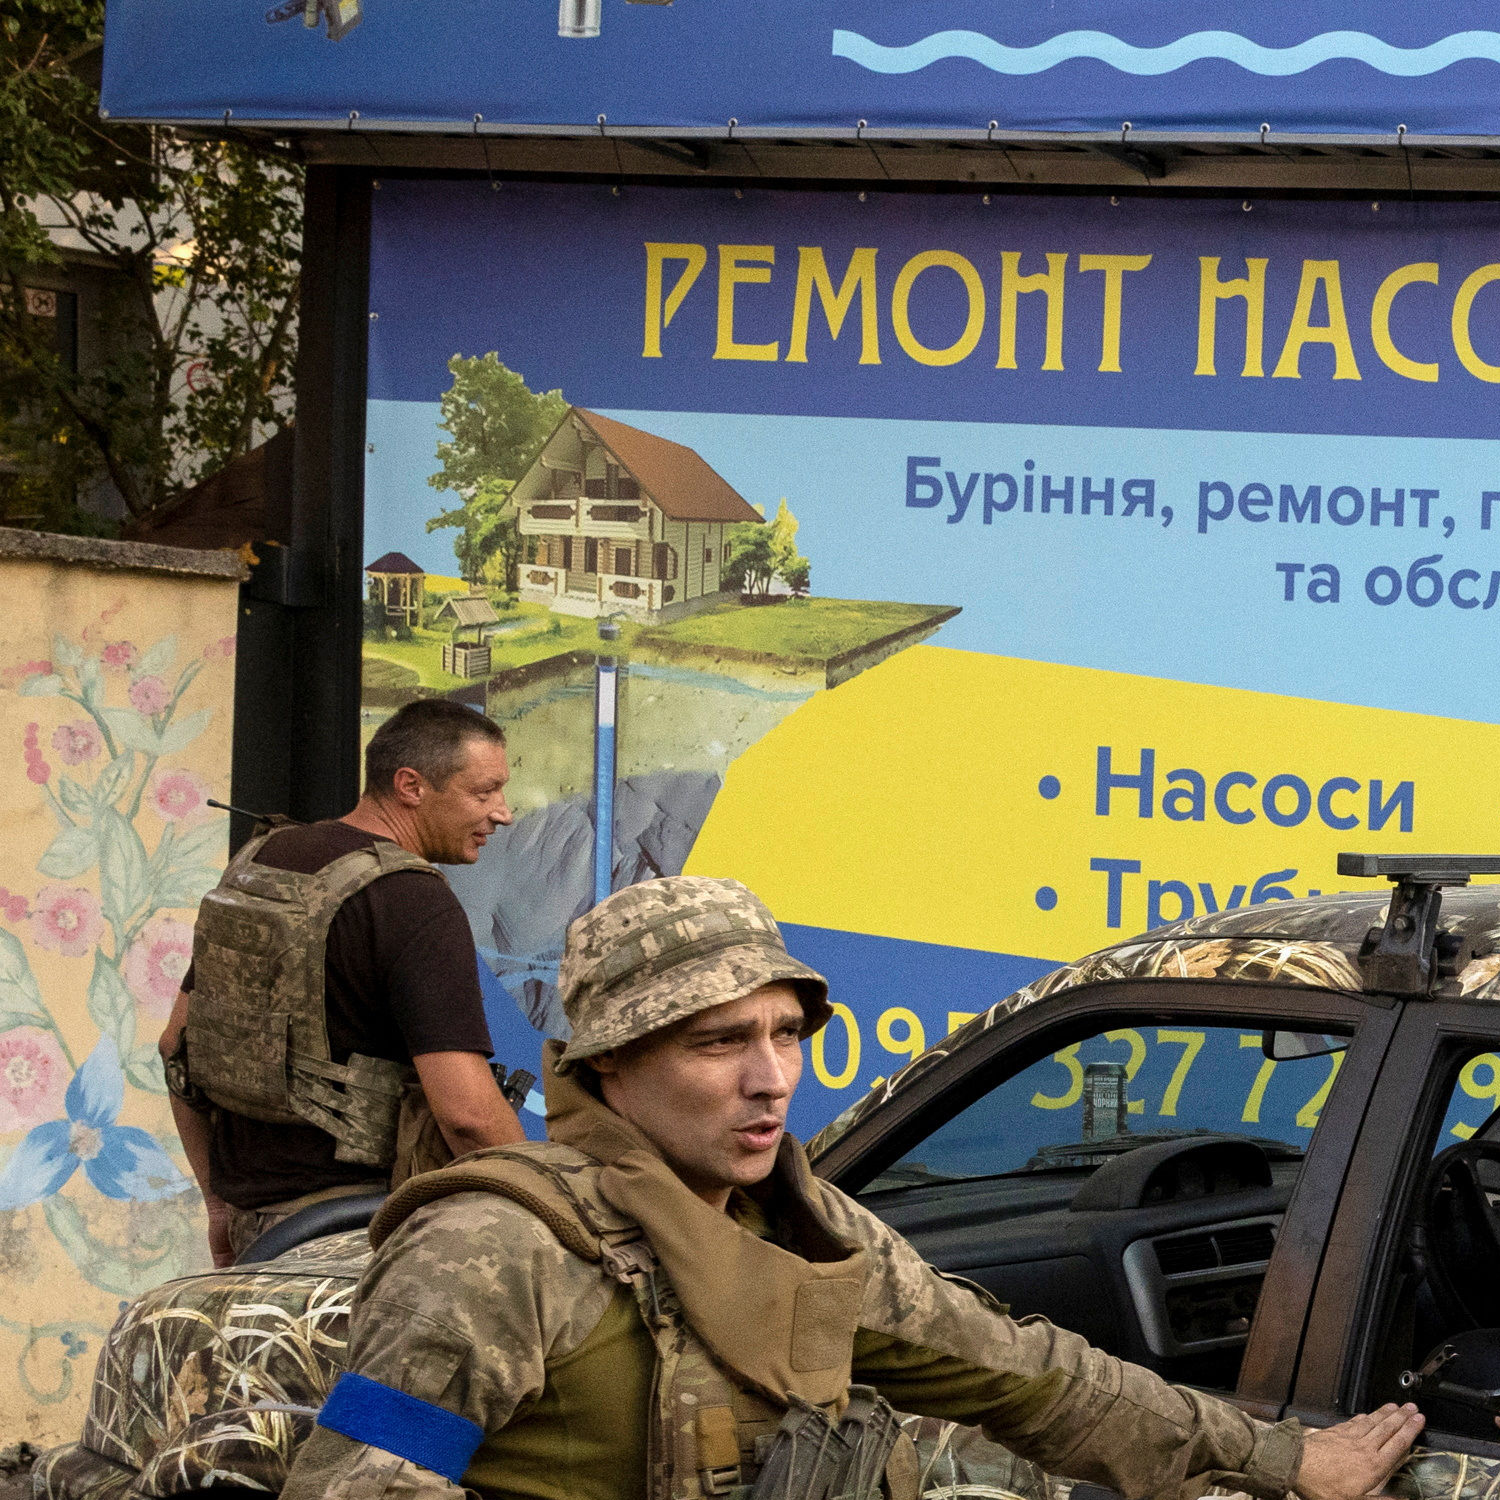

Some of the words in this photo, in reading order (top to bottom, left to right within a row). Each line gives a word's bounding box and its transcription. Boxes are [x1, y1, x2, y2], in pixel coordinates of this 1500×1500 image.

[642, 241, 1153, 372] РЕМОНТ
[905, 455, 1174, 528] Буріння,
[1197, 481, 1455, 538] ремонт,
[1275, 562, 1340, 604] та
[1096, 746, 1414, 833] Насоси
[1089, 857, 1322, 932] Труб
[810, 1002, 979, 1090] 09
